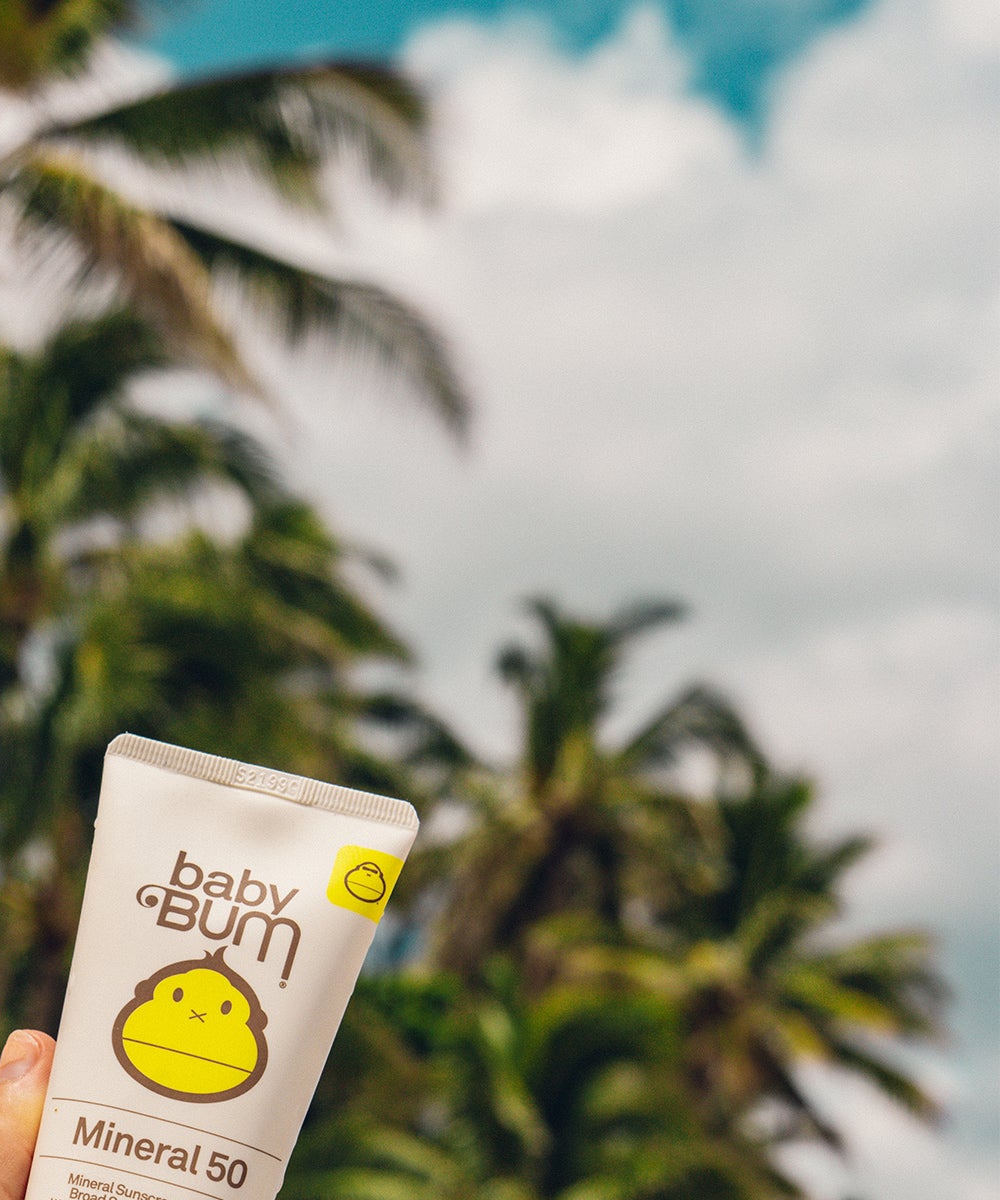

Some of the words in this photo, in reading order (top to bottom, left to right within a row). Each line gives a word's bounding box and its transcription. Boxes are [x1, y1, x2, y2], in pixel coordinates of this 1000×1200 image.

[169, 850, 299, 915] baby
[67, 1173, 114, 1193] Mineral
[72, 1116, 202, 1175] Mineral
[206, 1151, 248, 1189] 50
